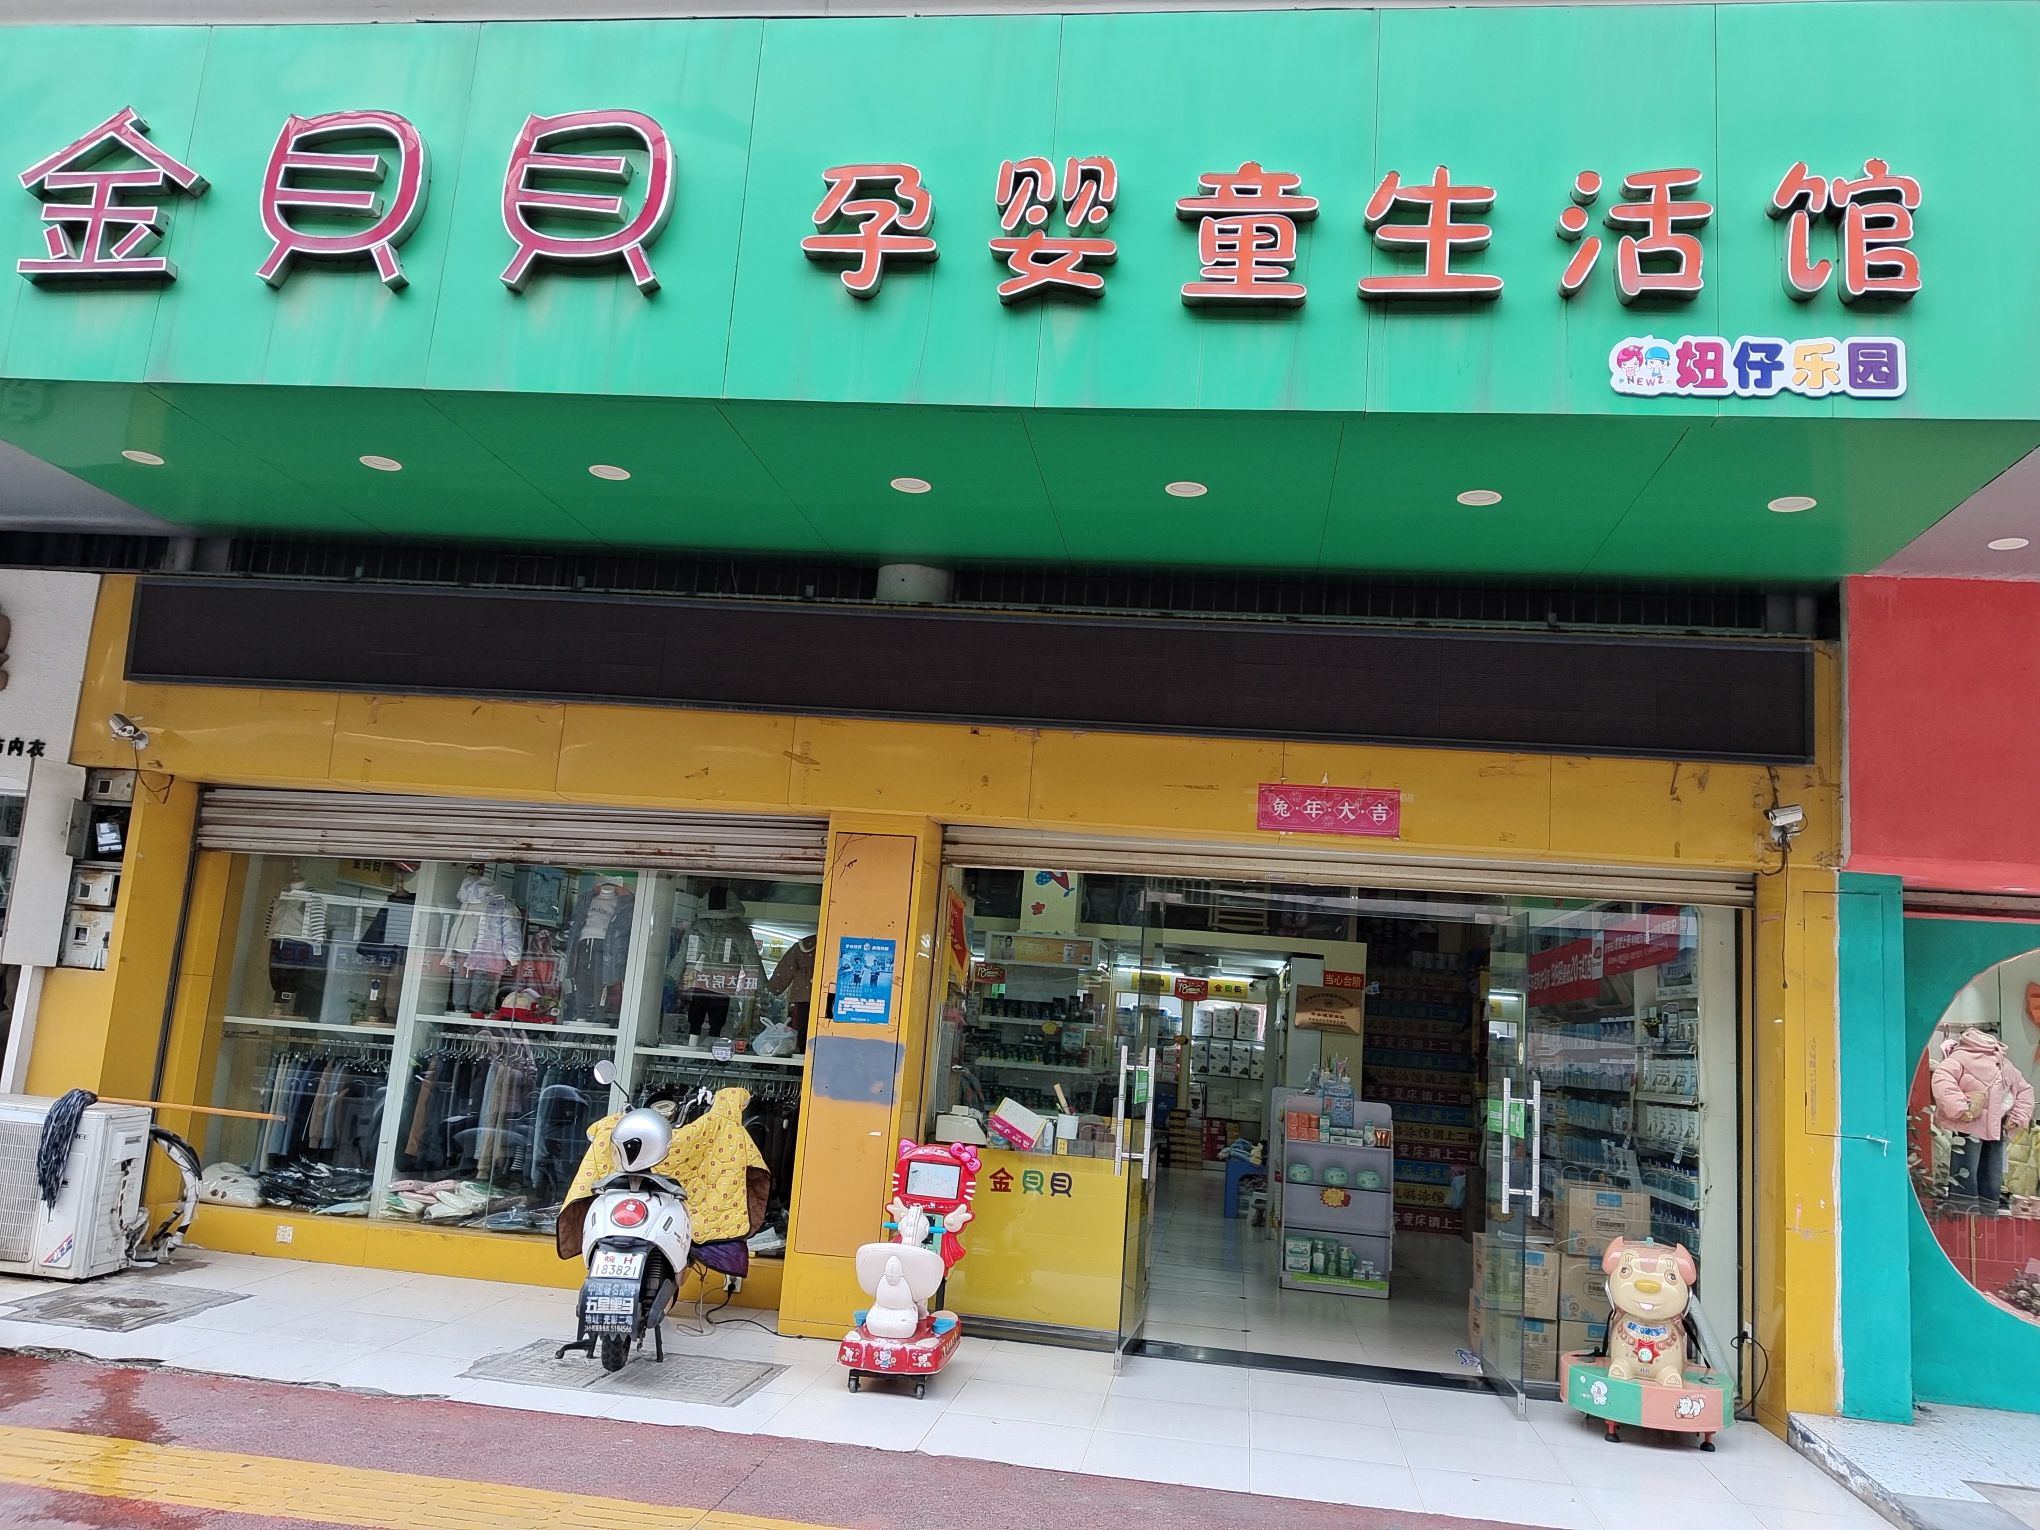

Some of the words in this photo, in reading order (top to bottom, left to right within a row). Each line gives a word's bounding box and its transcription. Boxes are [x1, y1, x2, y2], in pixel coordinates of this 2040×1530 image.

[18, 104, 678, 296] 金贝贝
[800, 157, 1922, 307] 孕婴童生活馆
[1675, 340, 1900, 390] 妞仔乐园
[1627, 375, 1665, 387] NEWZ
[1325, 973, 1362, 988] 当心台阶
[989, 1166, 1073, 1198] 金贝贝
[624, 1256, 633, 1264] H
[596, 1264, 637, 1276] 183821
